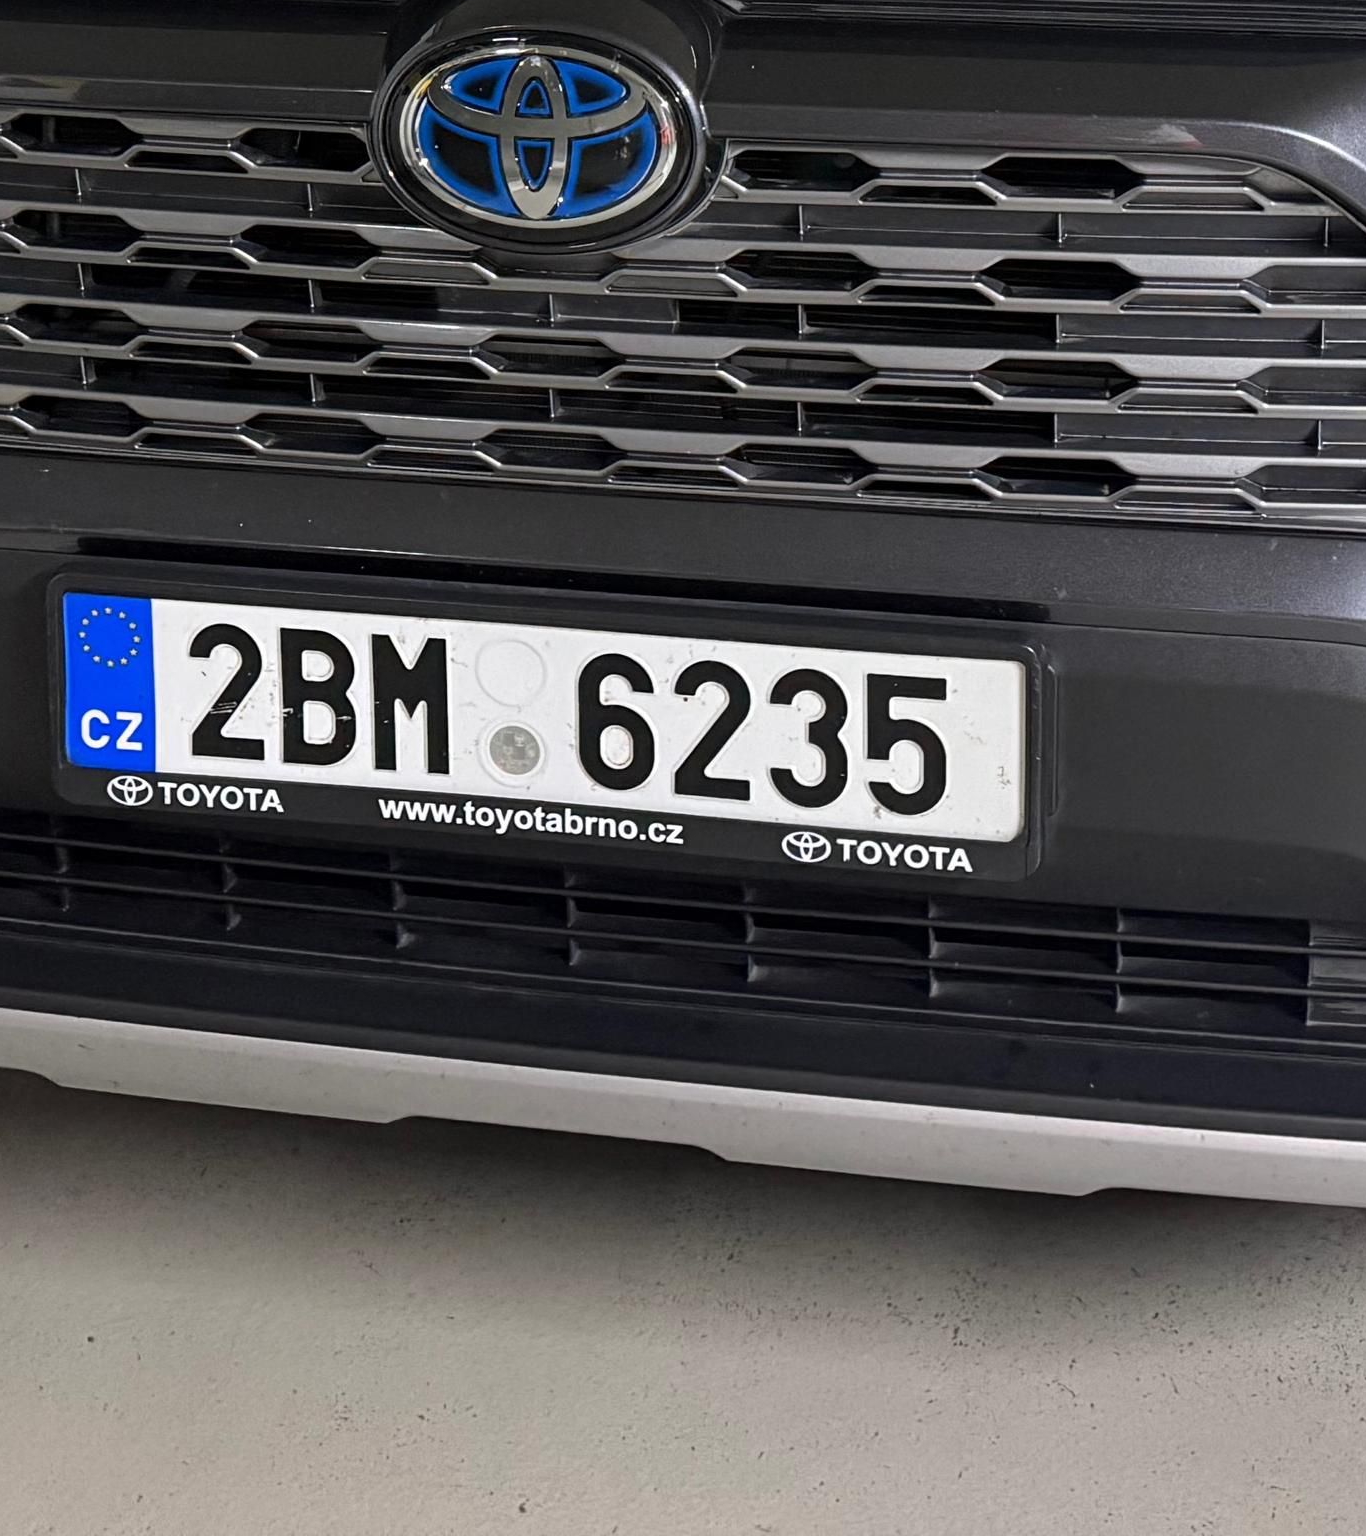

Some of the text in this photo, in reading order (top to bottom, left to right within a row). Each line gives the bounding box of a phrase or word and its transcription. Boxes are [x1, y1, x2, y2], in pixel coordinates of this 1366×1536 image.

[80, 708, 144, 752] CZ
[188, 622, 948, 816] 2BM 6235
[157, 780, 285, 813] TOYOTA
[378, 797, 685, 845] www.toyotabrno.cz
[835, 837, 973, 873] TOYOTA
